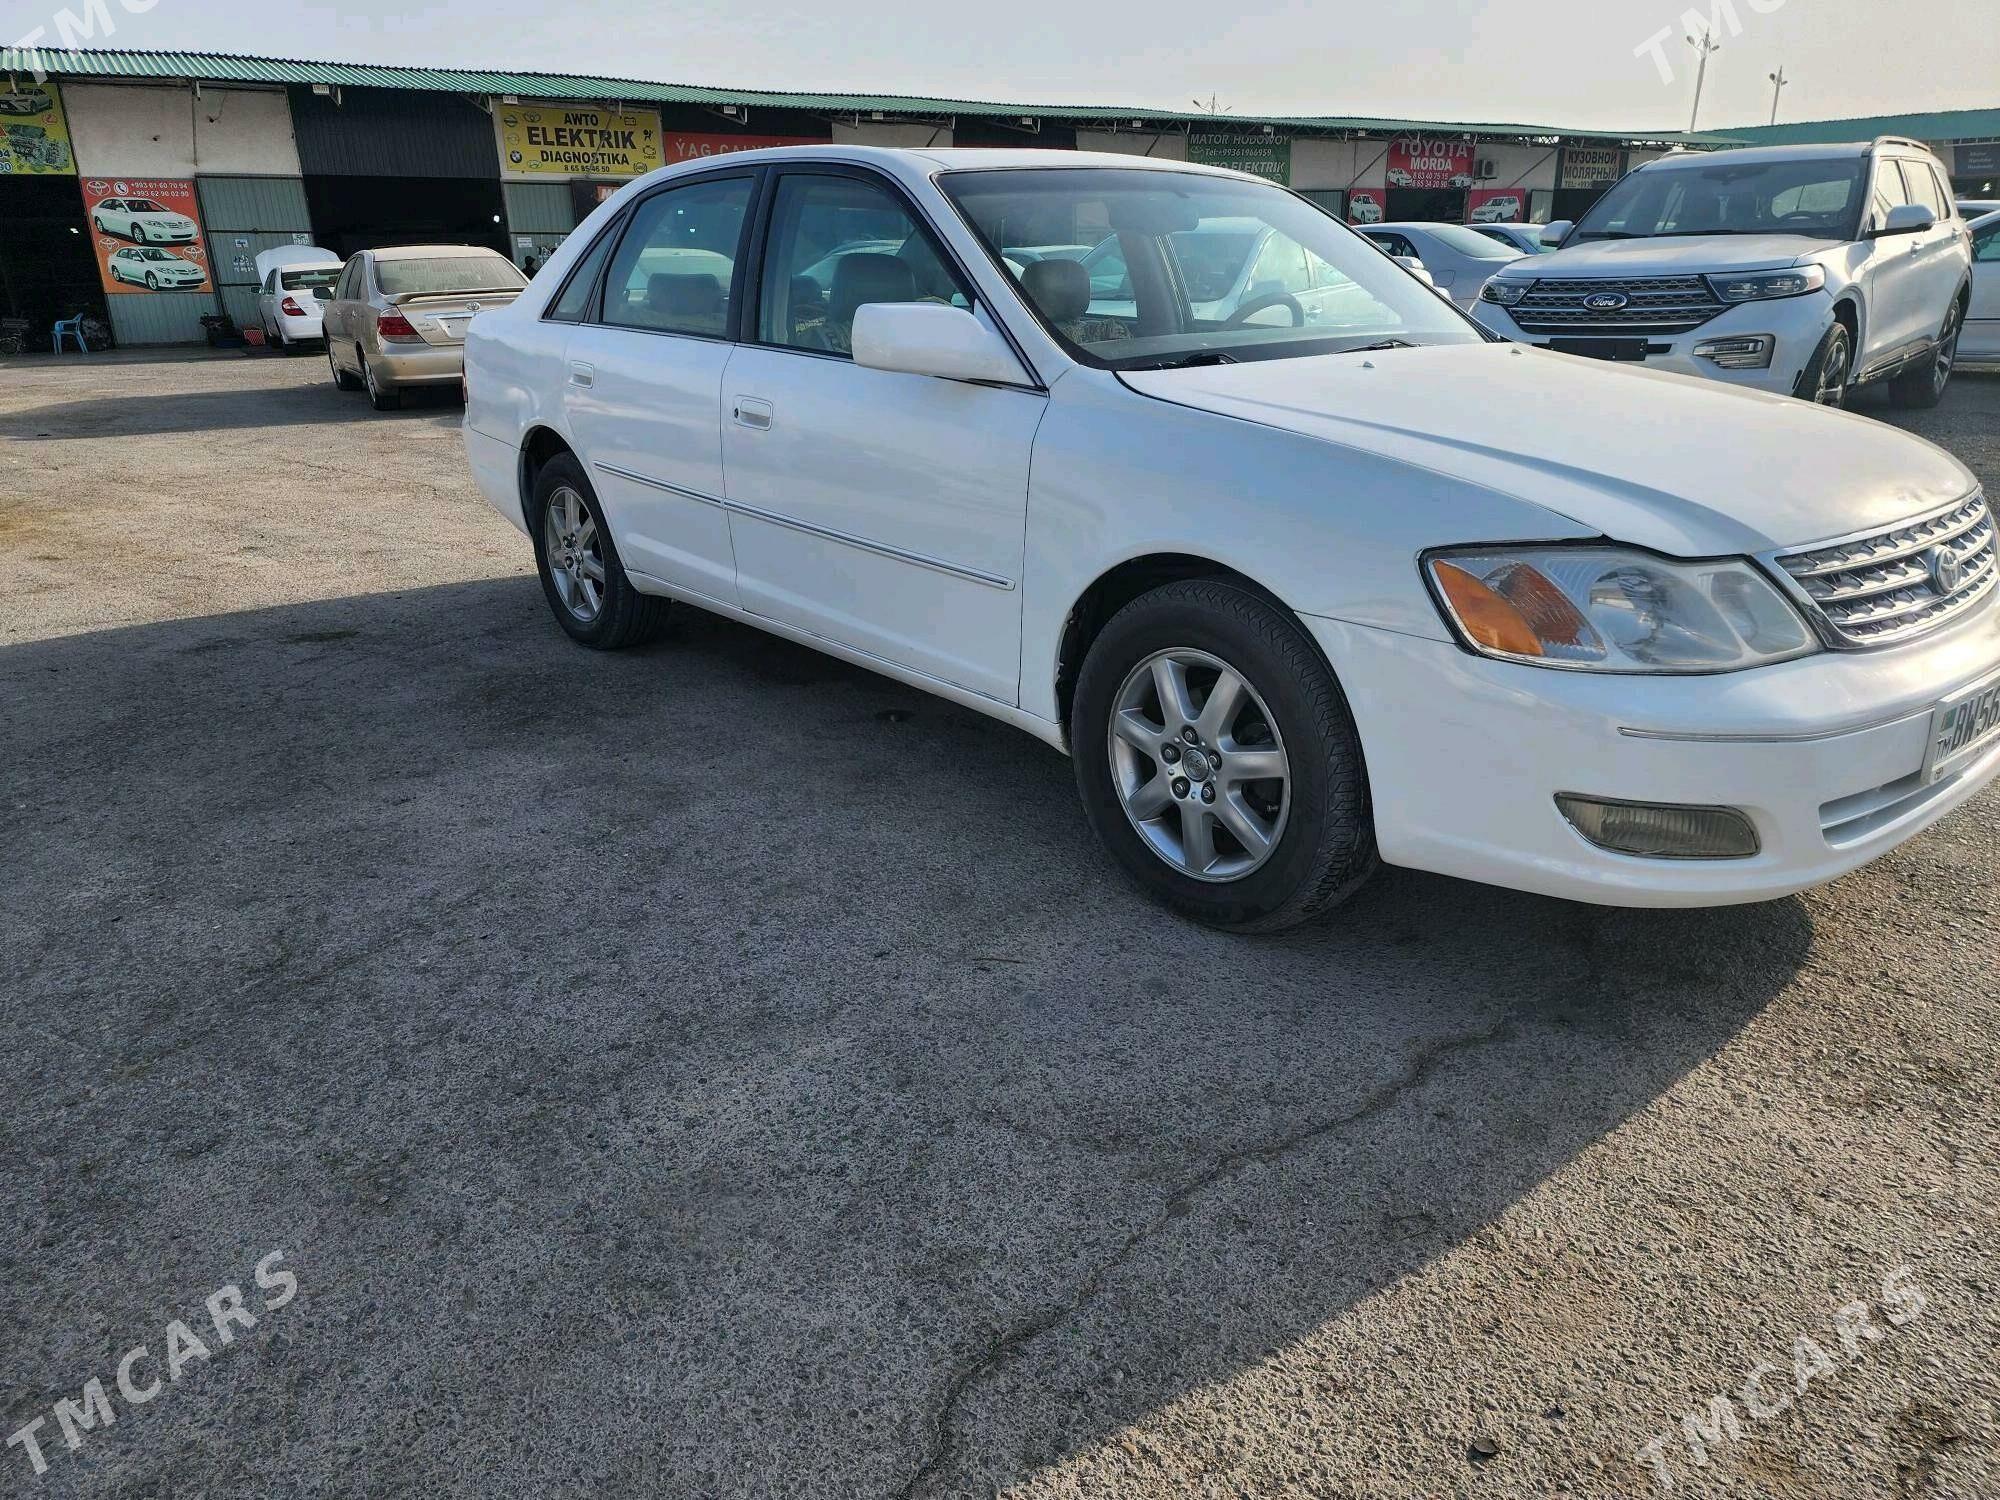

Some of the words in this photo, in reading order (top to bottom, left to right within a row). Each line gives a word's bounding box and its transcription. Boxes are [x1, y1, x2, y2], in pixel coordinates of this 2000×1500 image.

[564, 112, 599, 126] AWTO
[526, 126, 637, 150] ELEKTRIK
[1190, 133, 1229, 145] MATOR
[1400, 139, 1468, 158] TOYOTA
[540, 150, 630, 165] DIAGNOSTIKA
[1410, 157, 1453, 171] MORDA
[1567, 150, 1618, 164] КУЗОВНОЙ
[1231, 161, 1286, 173] ELEKTRIK
[1563, 166, 1618, 180] МОЛЯРНЫЙ
[1592, 295, 1617, 306] Ford
[1936, 735, 1952, 760] TM
